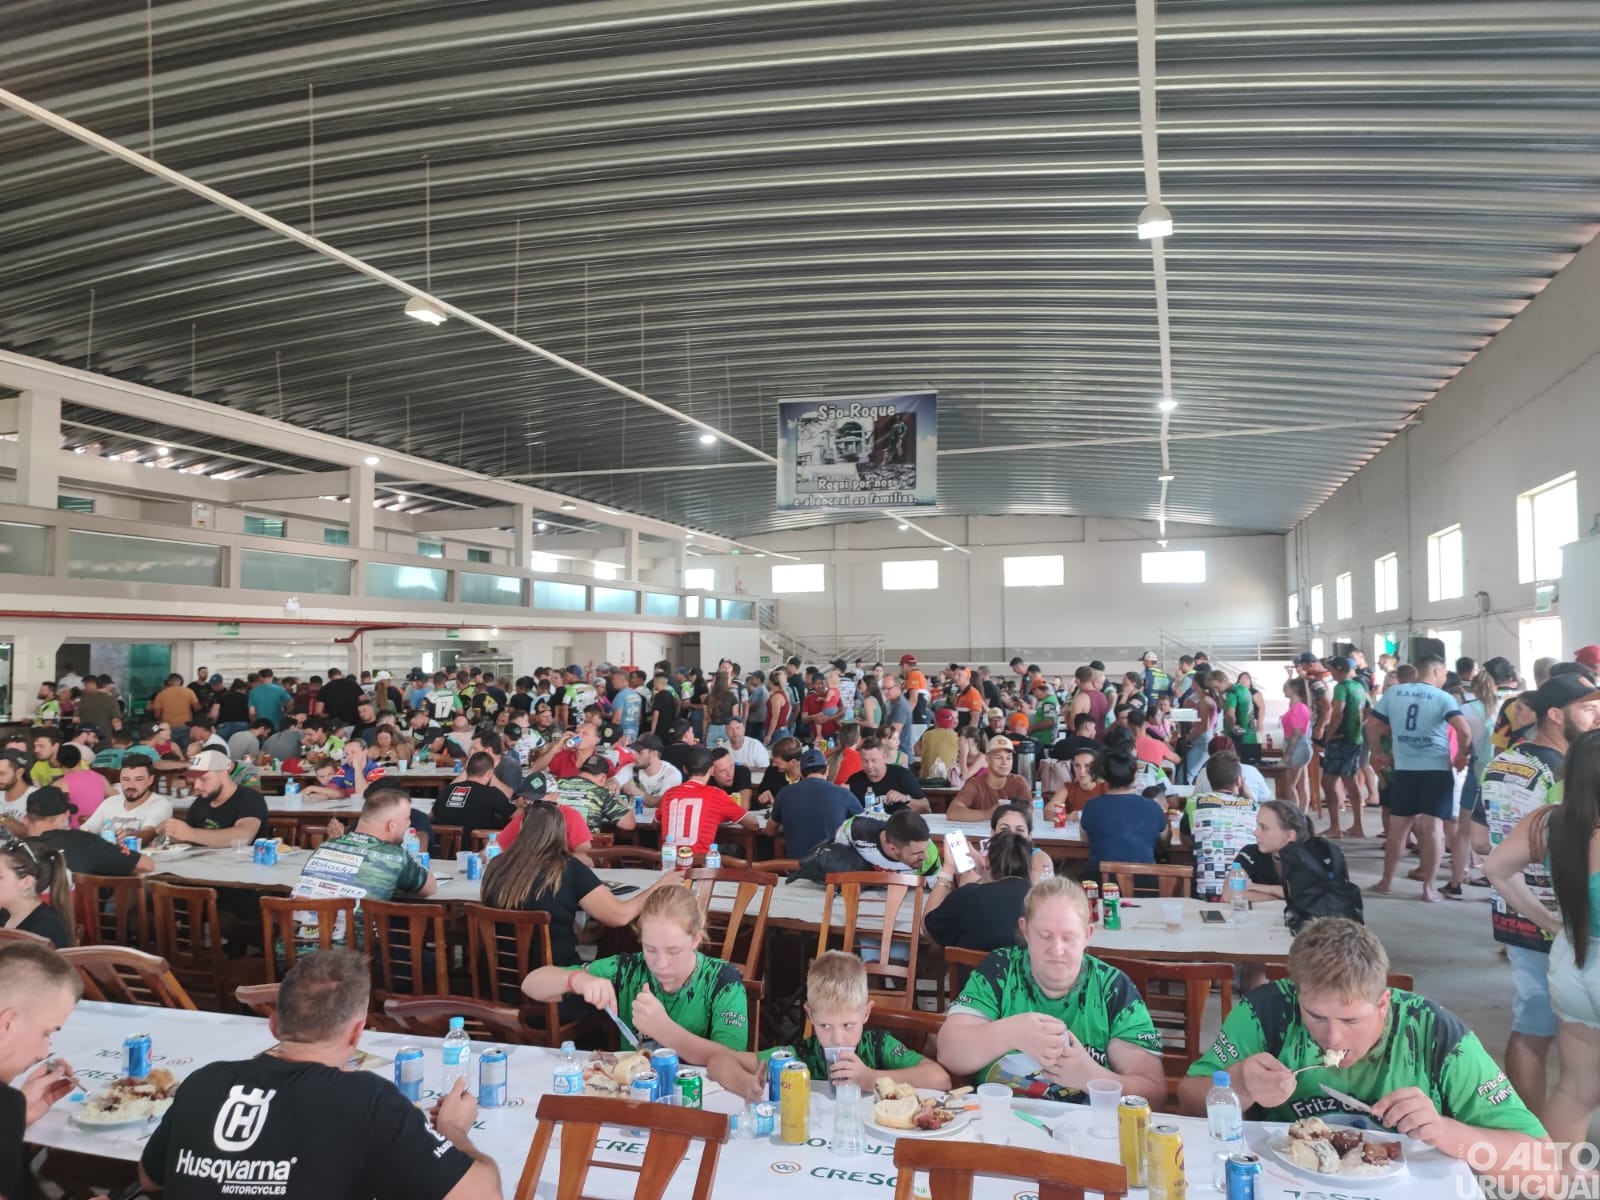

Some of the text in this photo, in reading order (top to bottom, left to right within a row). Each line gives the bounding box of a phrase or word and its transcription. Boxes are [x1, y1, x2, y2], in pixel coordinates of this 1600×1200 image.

[818, 403, 896, 421] São Roque
[818, 478, 848, 491] Rogai
[853, 479, 870, 491] por
[435, 695, 454, 719] 17
[1405, 703, 1419, 731] 8
[668, 798, 703, 846] 10
[1213, 1042, 1227, 1062] rilha
[1477, 1080, 1498, 1097] Fritz
[1292, 1099, 1337, 1117] Fritz
[176, 1148, 292, 1184] Husqvarna
[221, 1185, 287, 1195] MOTORCYCLES
